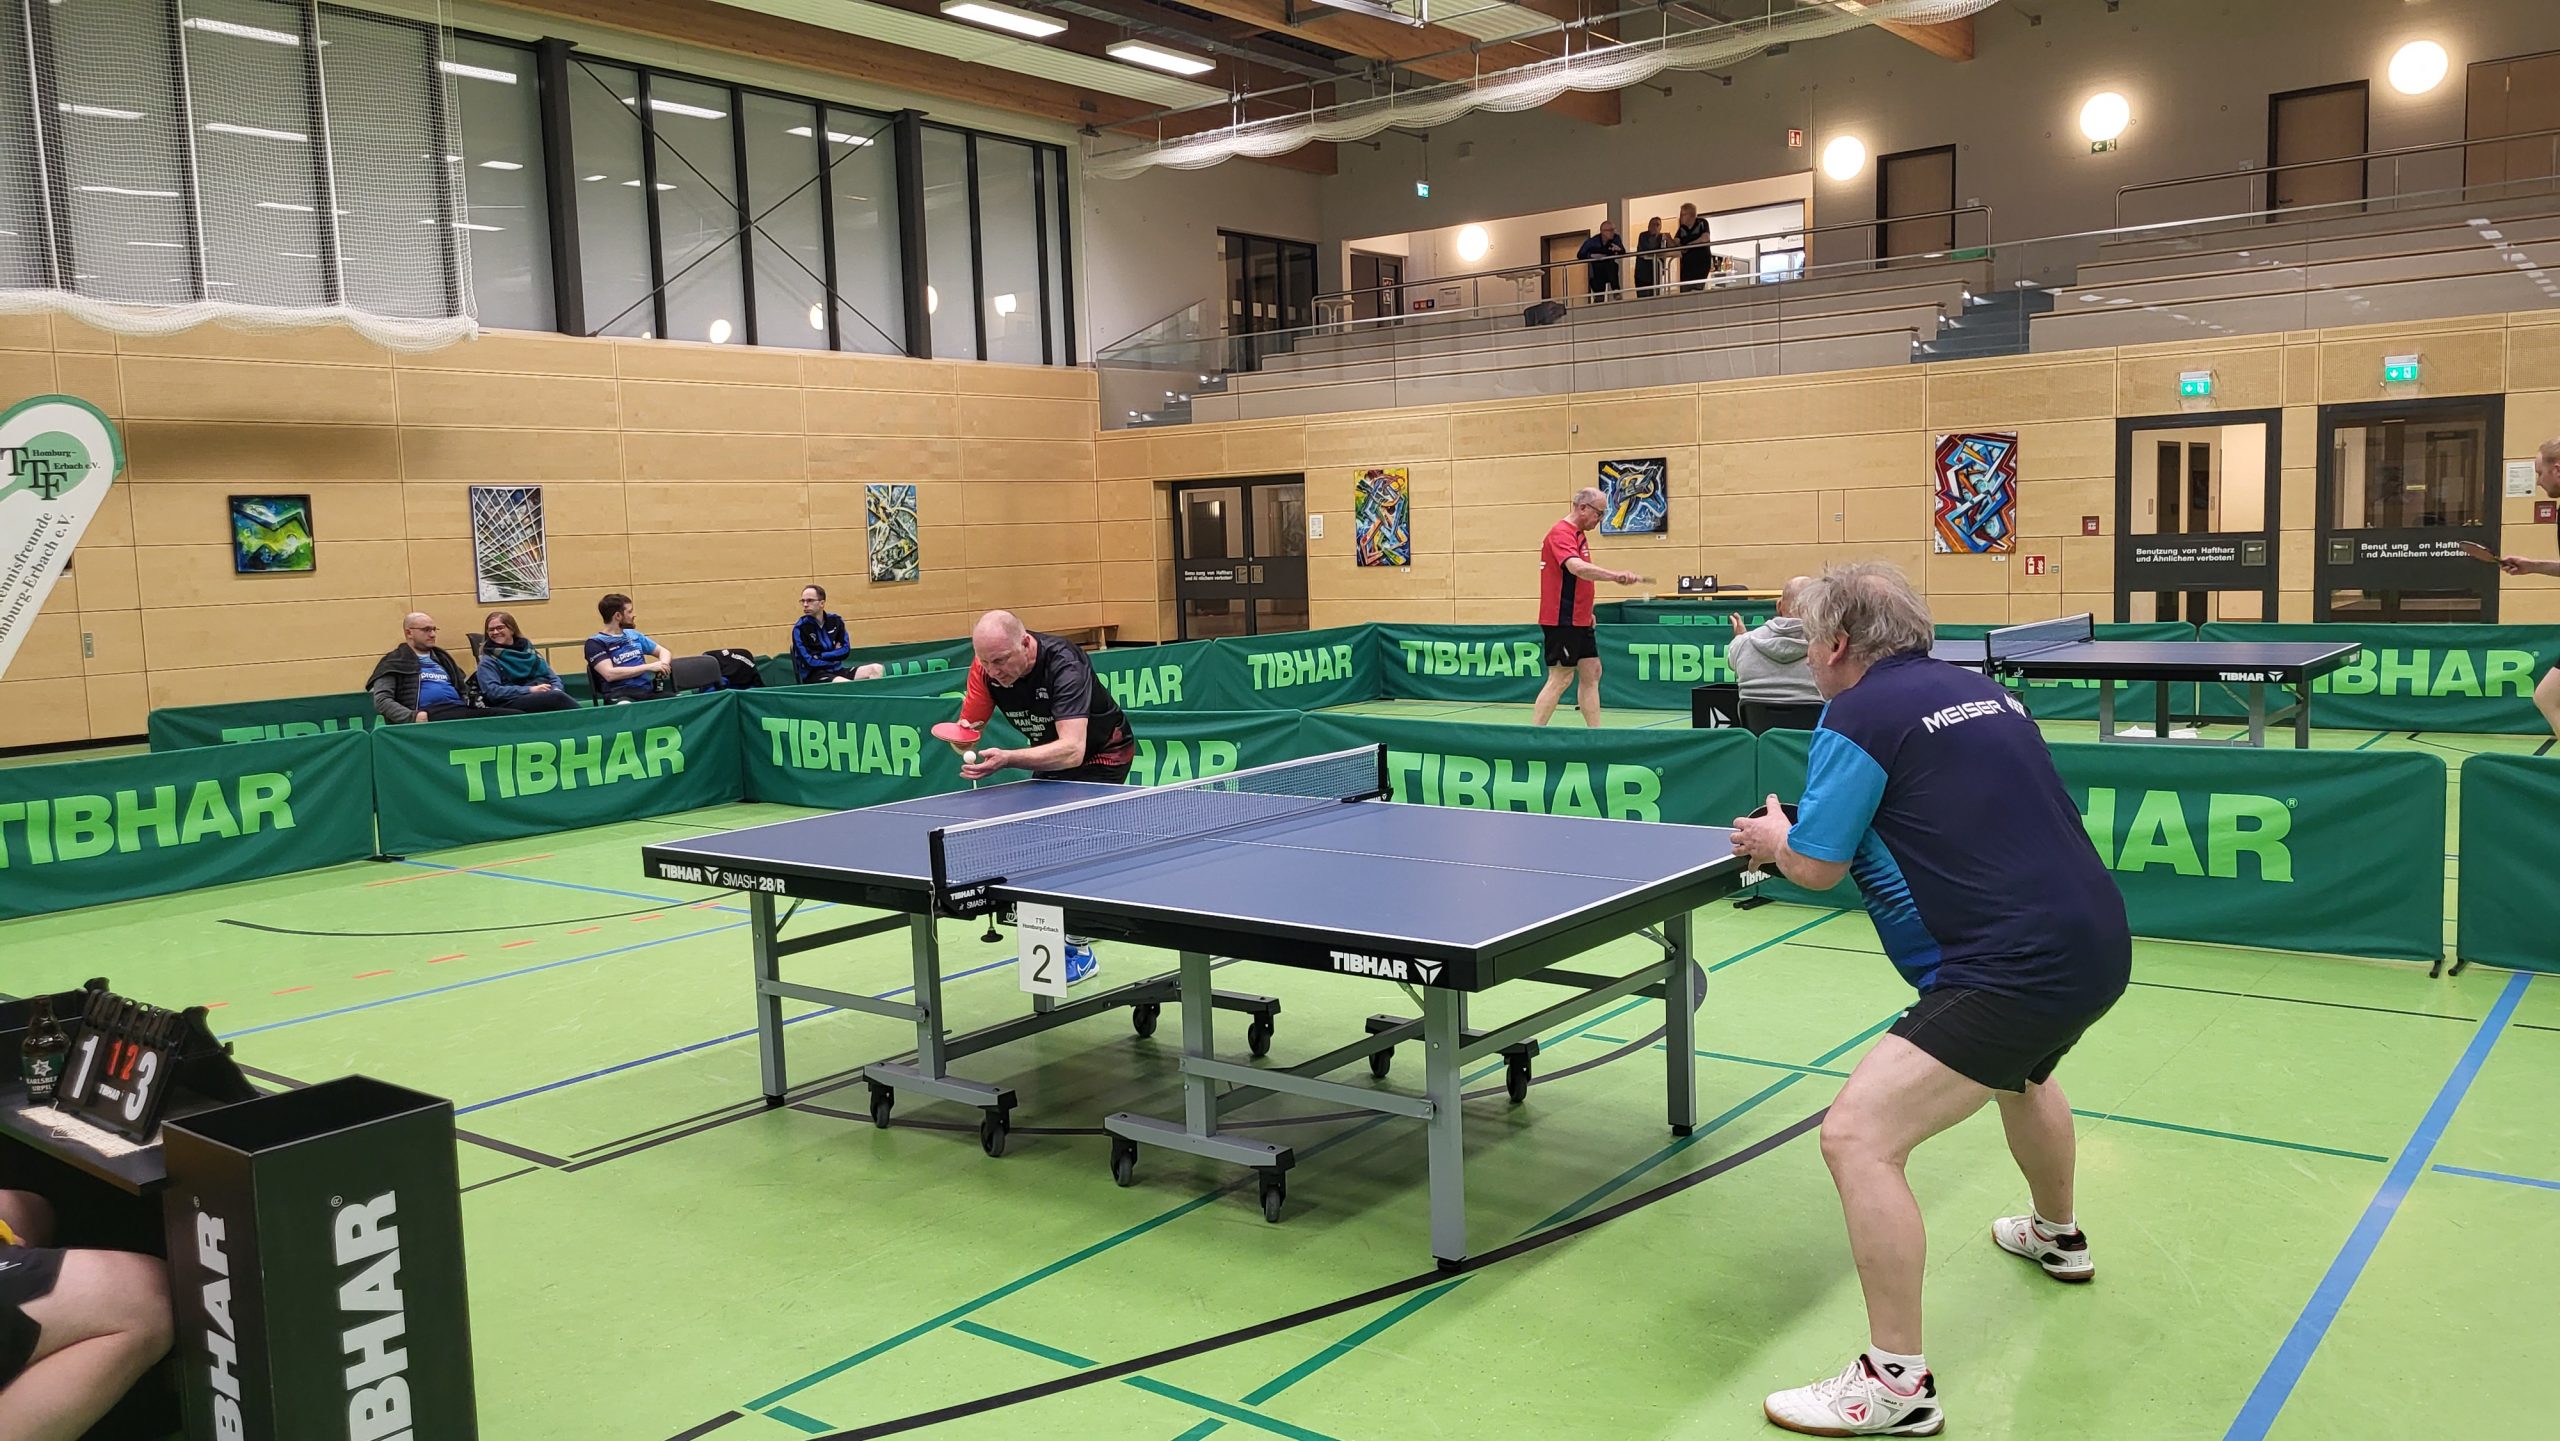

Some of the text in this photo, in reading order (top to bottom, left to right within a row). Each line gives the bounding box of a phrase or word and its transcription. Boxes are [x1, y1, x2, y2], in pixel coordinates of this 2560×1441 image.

[32, 449, 77, 458] Homburg-
[54, 462, 101, 470] Erbach e.V.
[0, 512, 53, 600] ennisfreunde
[2136, 548, 2178, 556] Benutzung
[2201, 546, 2235, 554] Haftharz
[2435, 541, 2460, 549] Hafth
[0, 514, 75, 643] omburg-Erbach e.V.
[1682, 577, 1713, 588] 6 4
[1247, 644, 1353, 691] TIBHAR
[1399, 640, 1542, 677] TIBHAR
[1628, 643, 1738, 683] TIBH
[2219, 672, 2265, 682] TIBHAR
[1097, 664, 1183, 709] HAR
[1921, 700, 2007, 734] MEISER
[450, 726, 685, 802] TIBHAR
[762, 717, 923, 778] TIBHAR
[658, 863, 786, 894] TIBHAR SMASH 28/R
[950, 888, 976, 901] TIBHAR
[966, 898, 987, 910] SMASH
[1035, 917, 1046, 925] TTF
[1032, 944, 1052, 985] 2
[1330, 950, 1408, 980] TIBHAR
[71, 1035, 100, 1099] 1
[107, 1039, 140, 1081] 1 2
[124, 1051, 158, 1122] 3
[197, 1211, 244, 1441] BHAR
[334, 1189, 414, 1441] BHAR
